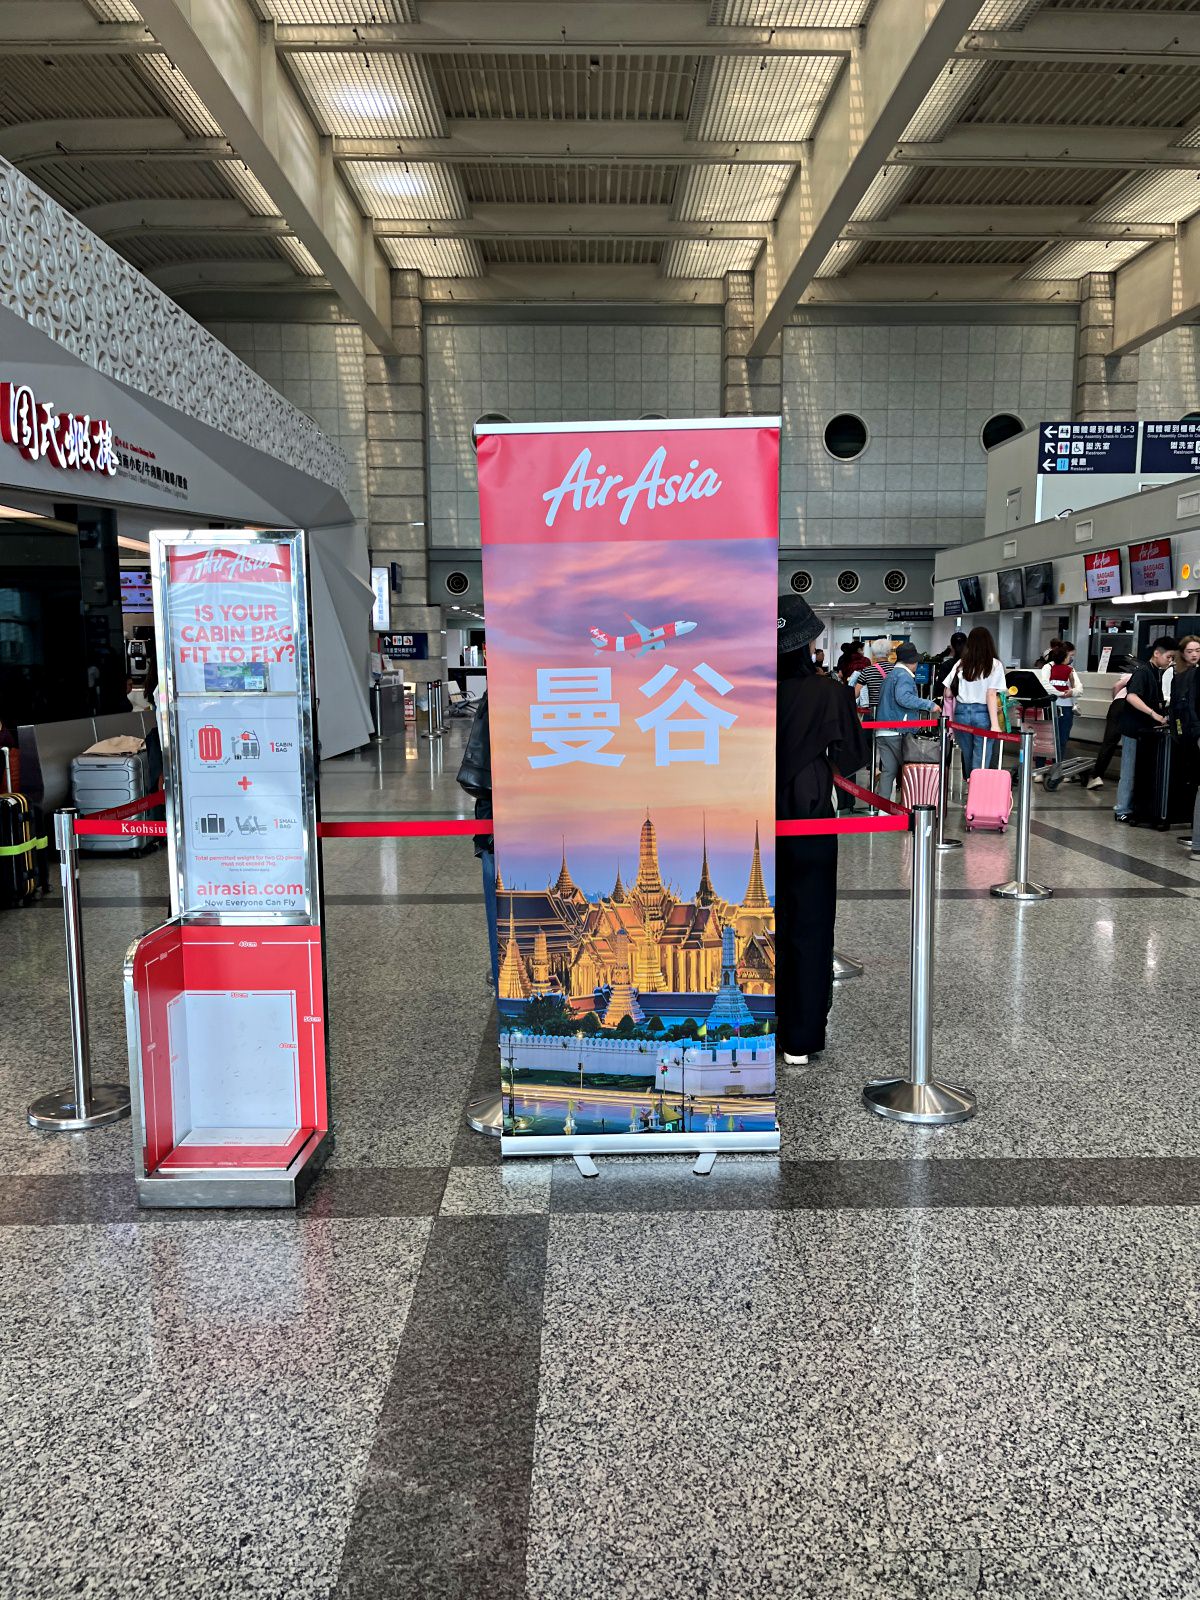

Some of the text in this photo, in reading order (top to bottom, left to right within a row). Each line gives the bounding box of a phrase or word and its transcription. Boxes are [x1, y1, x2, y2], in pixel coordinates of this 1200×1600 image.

[1143, 563, 1165, 572] BAGGAGE
[1143, 571, 1156, 579] DROP
[1096, 579, 1108, 587] DROP
[195, 604, 278, 622] IS YOUR
[180, 625, 293, 643] CABIN BAG
[180, 644, 296, 663] FIT TO FLY?
[527, 662, 739, 769] 曼谷
[269, 742, 275, 752] 1
[273, 818, 279, 829] 1
[197, 881, 303, 896] airasia.com
[205, 899, 223, 907] Now
[225, 899, 263, 907] Everyone
[283, 899, 296, 907] Fly
[238, 940, 257, 948] 40cm
